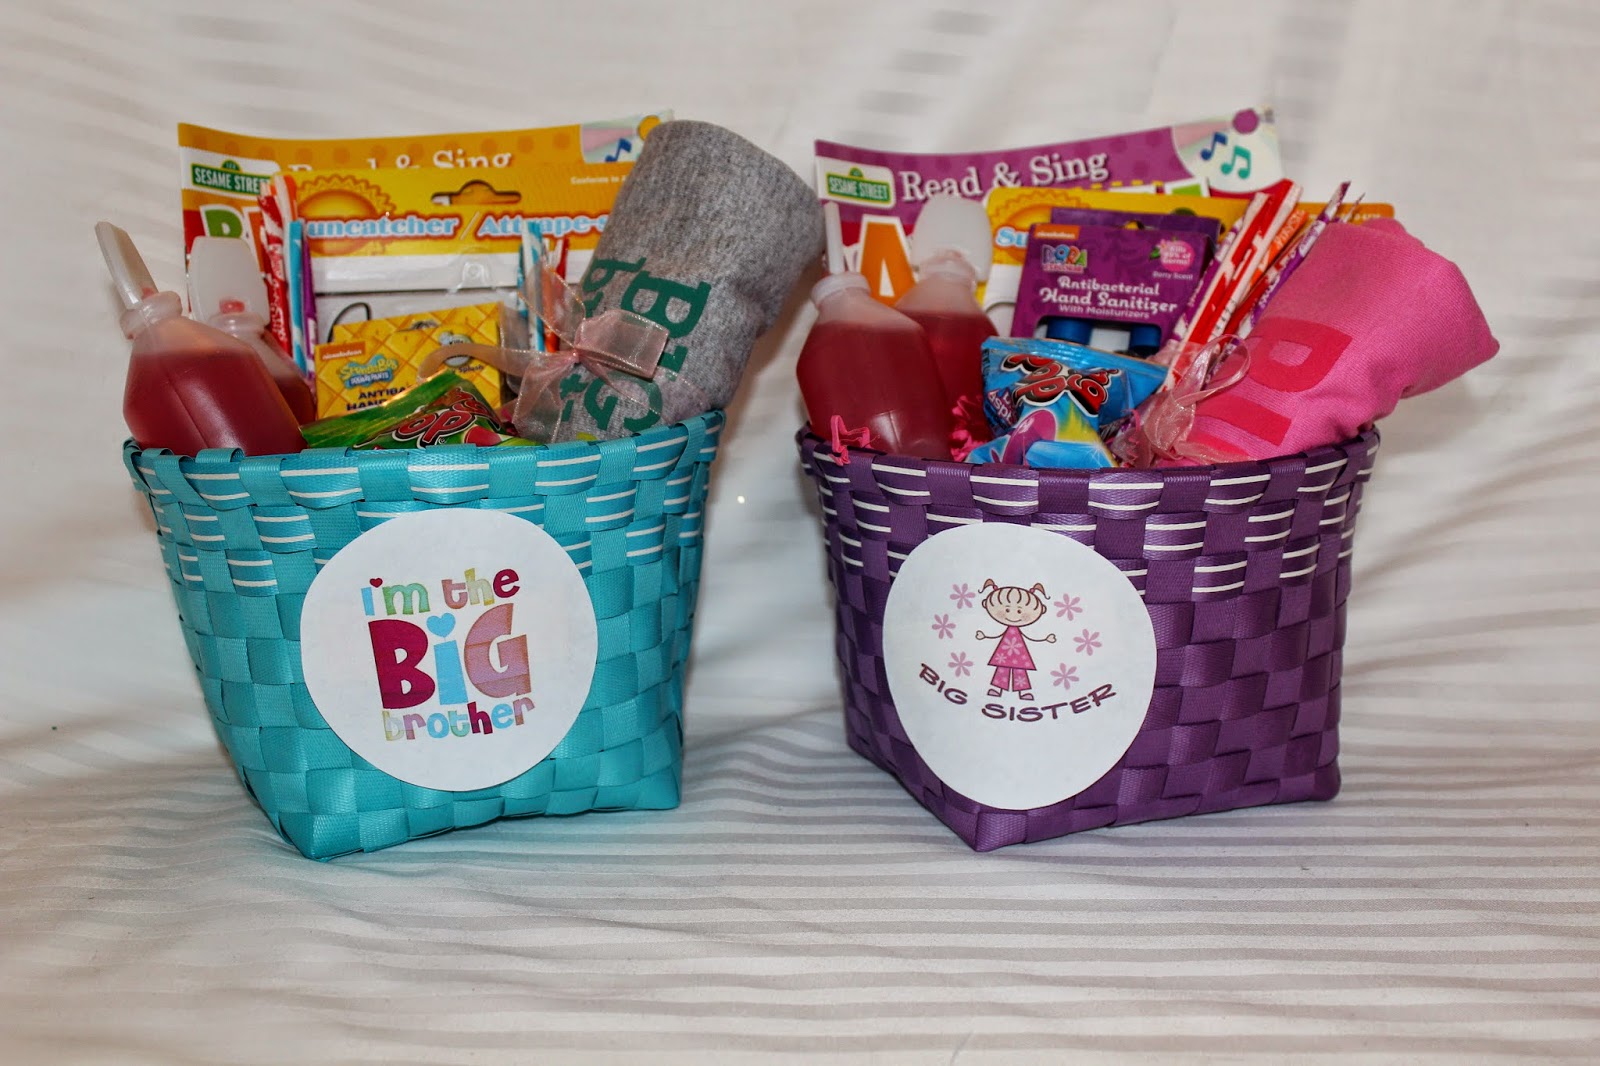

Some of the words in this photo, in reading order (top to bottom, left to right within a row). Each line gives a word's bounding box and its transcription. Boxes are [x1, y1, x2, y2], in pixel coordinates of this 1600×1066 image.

[194, 167, 232, 191] SESAME
[234, 177, 270, 194] STRE
[829, 175, 857, 196] SESAME
[899, 166, 983, 201] Read
[992, 161, 1022, 189] &
[1030, 152, 1109, 187] Sing
[304, 214, 460, 237] uncatcher
[1042, 244, 1087, 269] DORA
[1057, 275, 1160, 296] Antibacterial
[1039, 286, 1096, 305] Hand
[1098, 291, 1178, 314] Sanitizer
[1059, 303, 1084, 314] With
[1086, 305, 1150, 319] Moisturizers
[441, 567, 521, 610] the
[918, 662, 968, 705] BIG
[981, 683, 1117, 722] SISTER
[382, 697, 536, 742] brother
